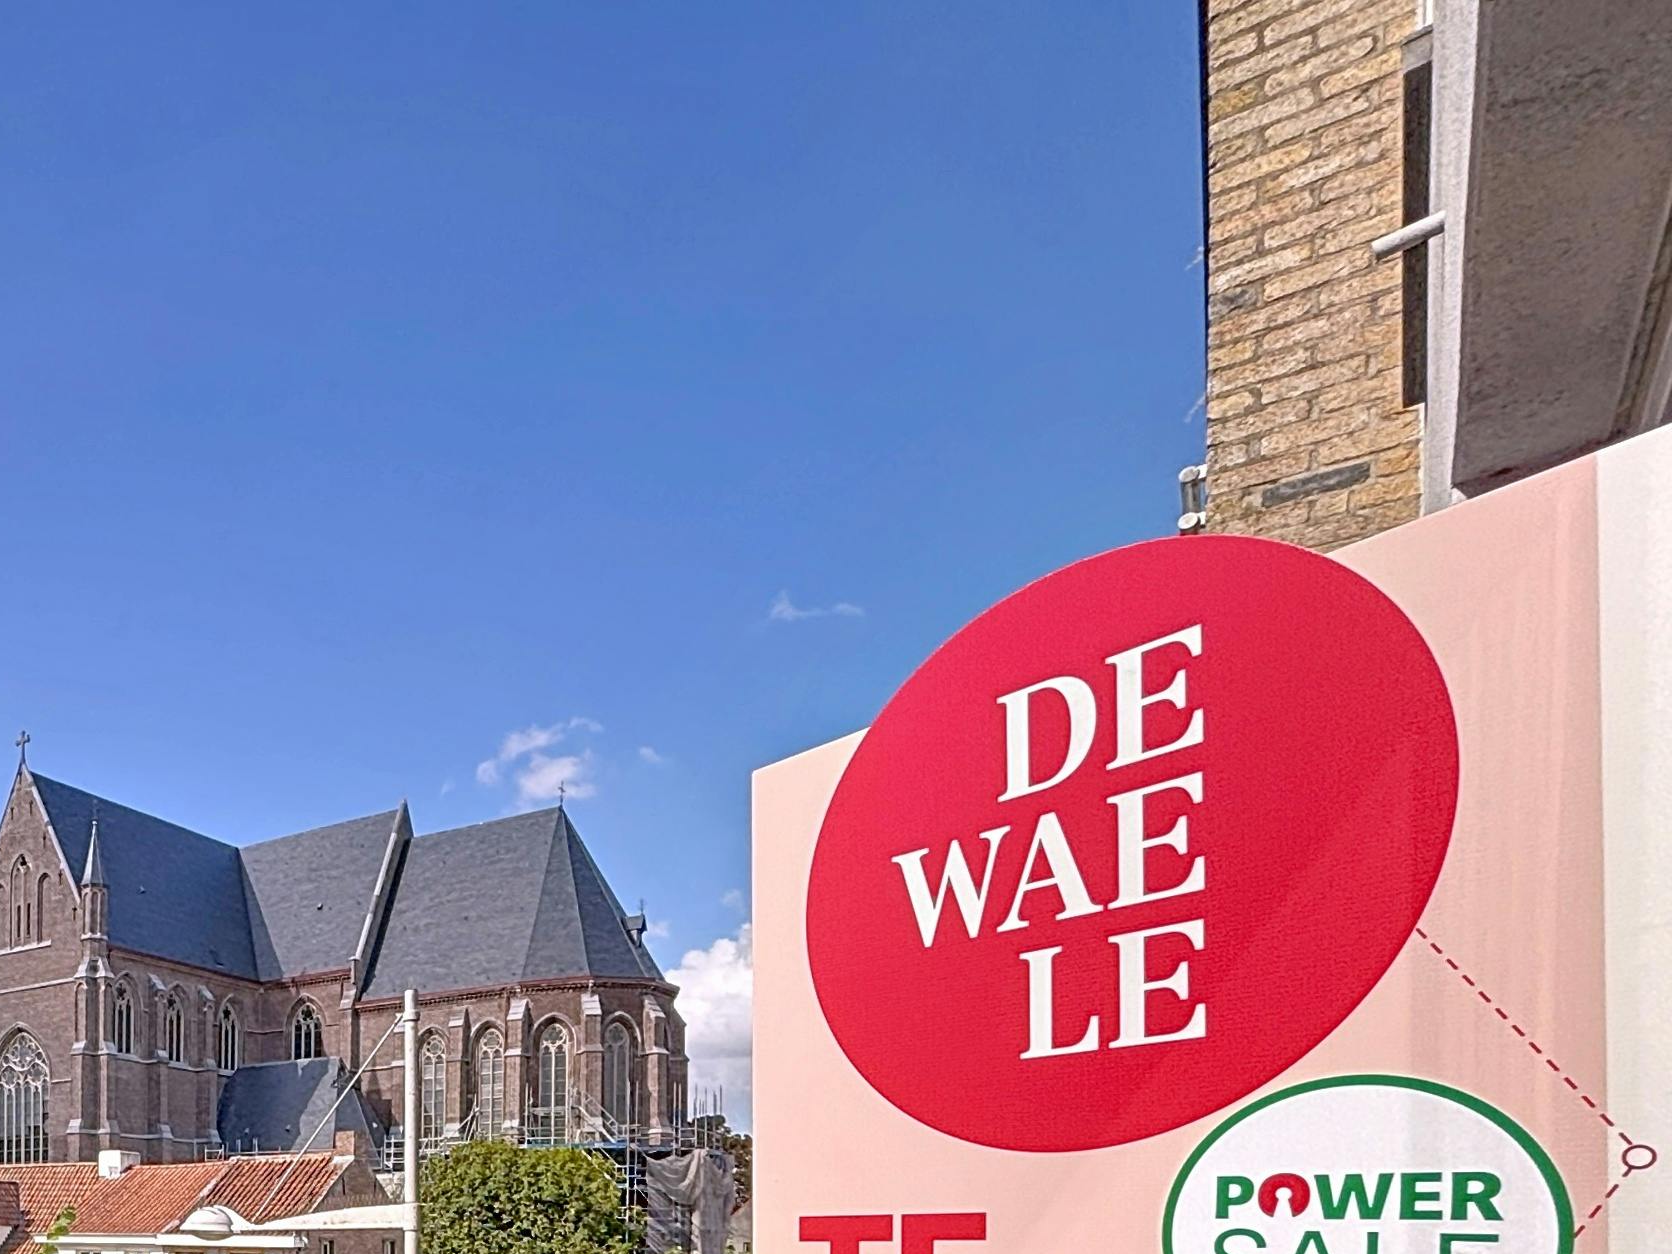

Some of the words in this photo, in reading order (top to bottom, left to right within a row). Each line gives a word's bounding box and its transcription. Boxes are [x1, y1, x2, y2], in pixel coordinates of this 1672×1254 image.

[996, 624, 1206, 804] DE
[891, 771, 1206, 948] WAE
[1018, 918, 1207, 1061] LE
[1214, 1171, 1505, 1221] POWER
